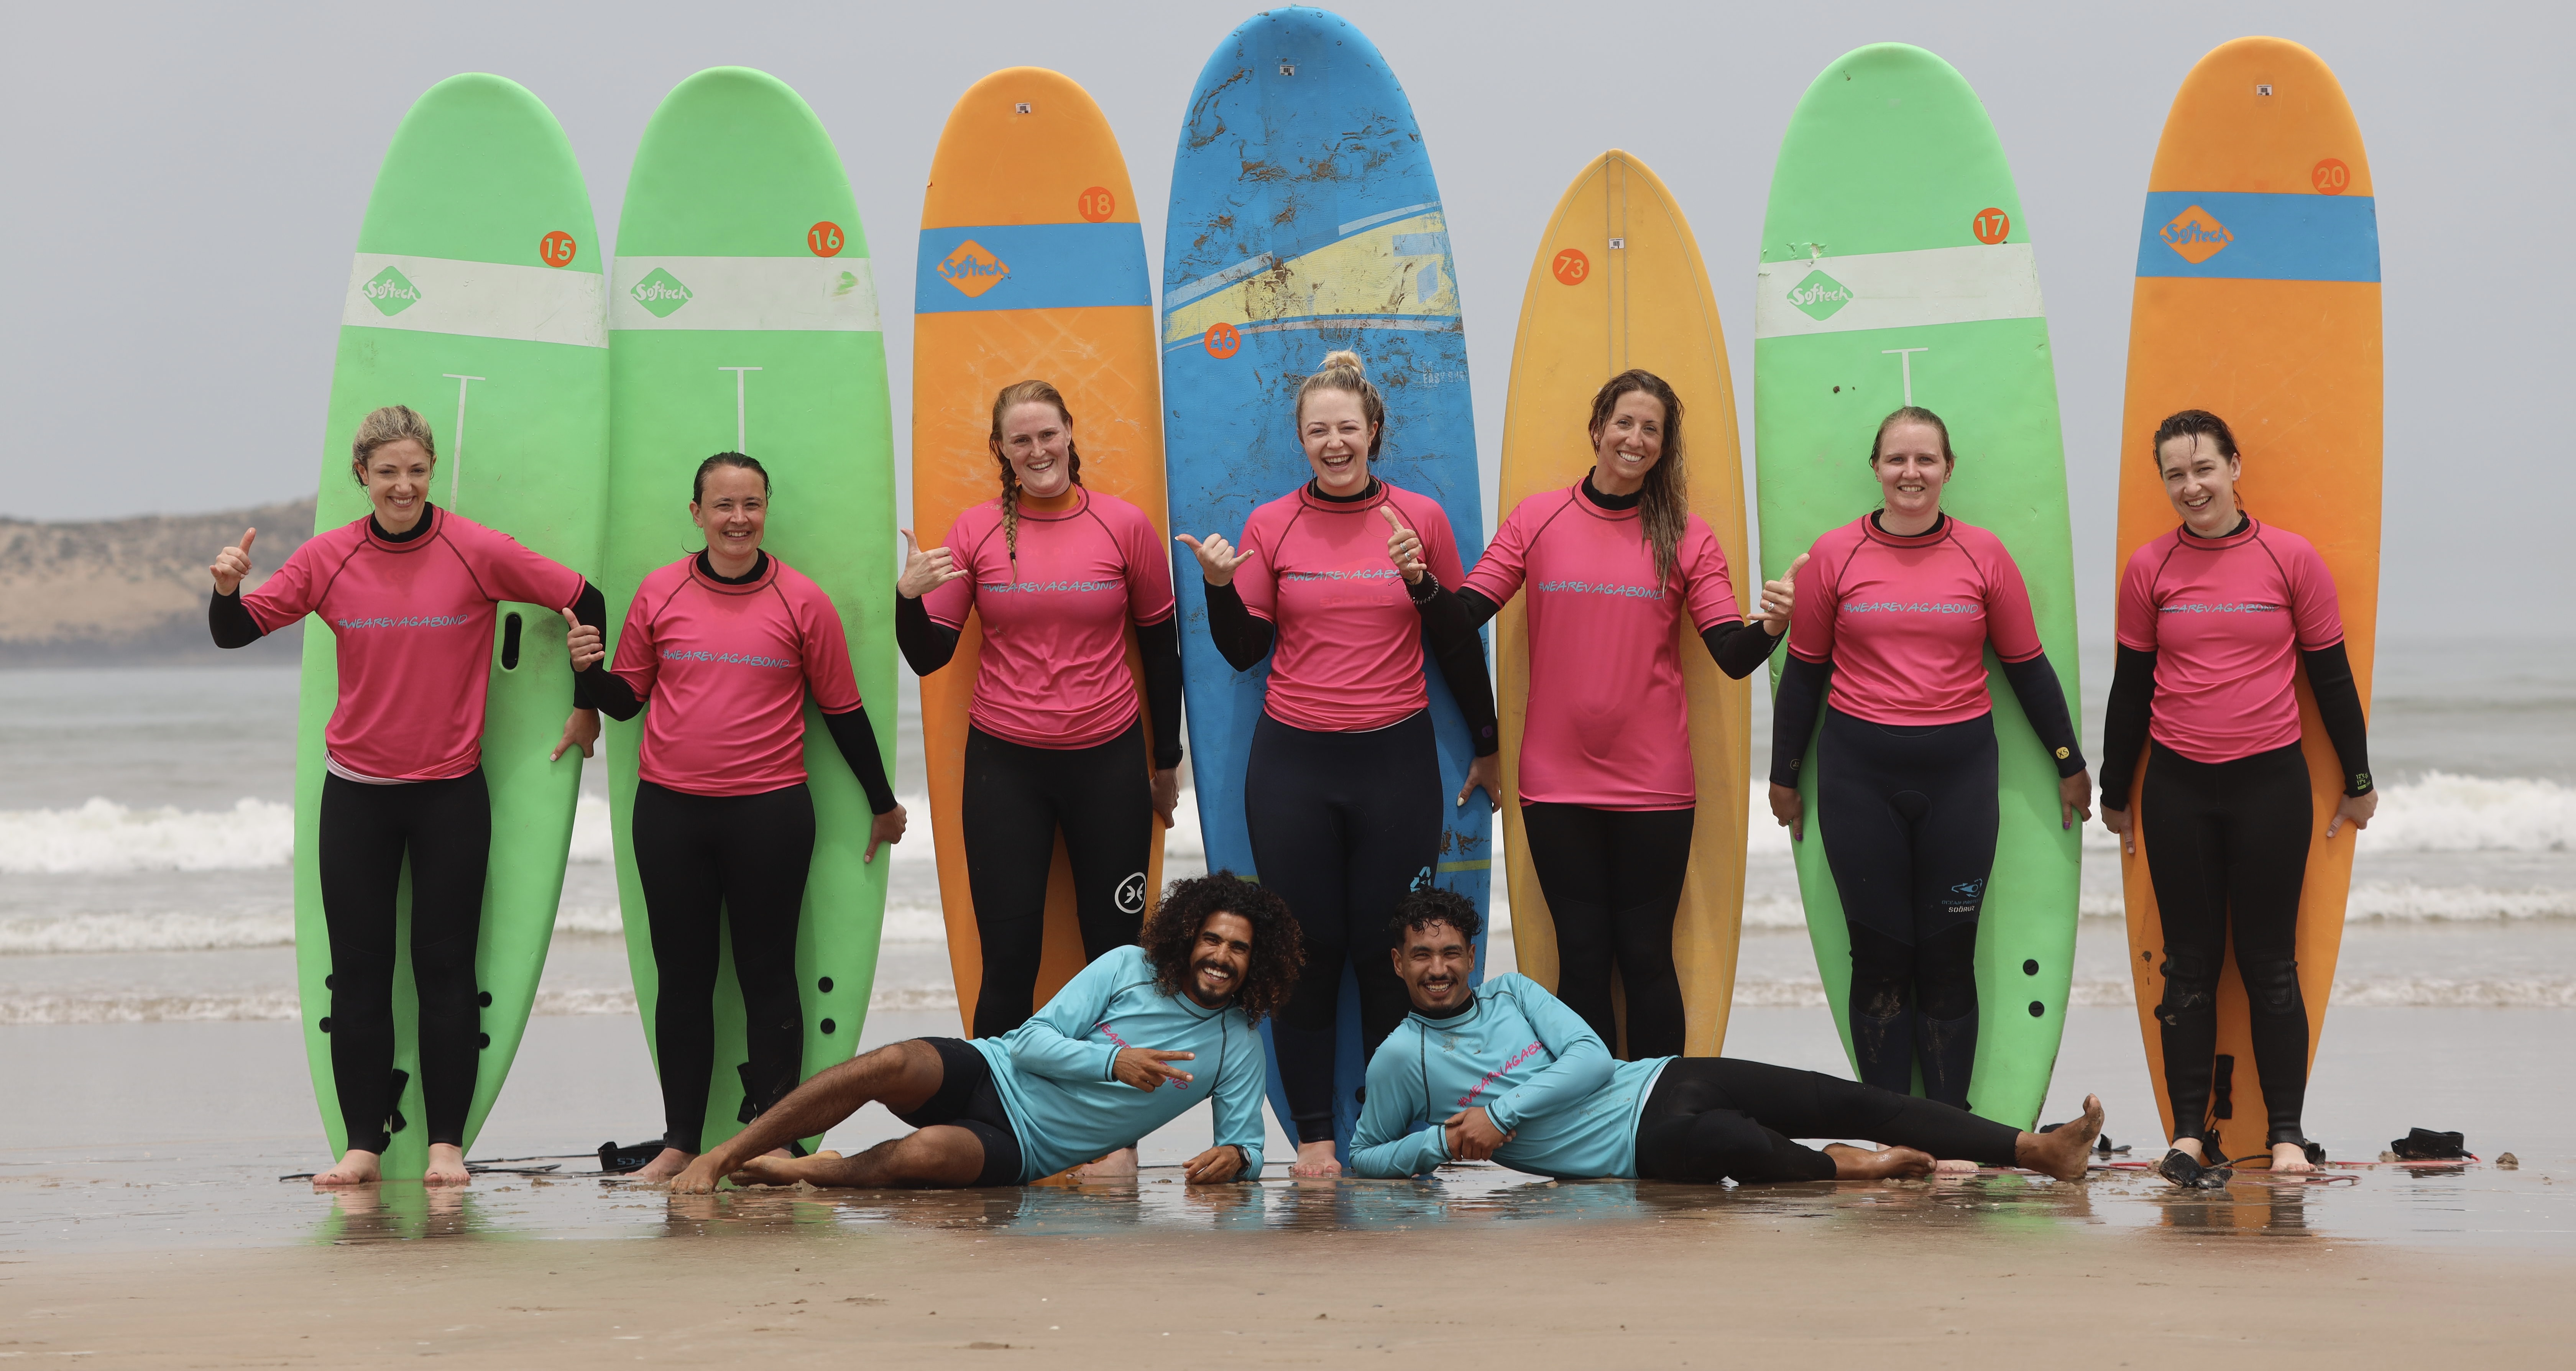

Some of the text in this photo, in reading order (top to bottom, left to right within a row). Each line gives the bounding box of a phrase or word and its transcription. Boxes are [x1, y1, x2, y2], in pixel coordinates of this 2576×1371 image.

[2317, 166, 2345, 188] 20
[1083, 194, 1111, 215] 18
[1977, 214, 2005, 237] 17
[2160, 220, 2233, 244] Softech
[545, 238, 572, 260] 15
[811, 228, 840, 250] 16
[937, 254, 1005, 279] Softech
[1558, 256, 1584, 278] 73
[363, 279, 421, 302] Softech
[631, 280, 690, 301] Softech
[1787, 283, 1852, 305] Softech
[1211, 330, 1235, 351] 46
[1287, 568, 1401, 582] #WEAREVAGABO
[982, 580, 1118, 593] #WEAREVAGABOND
[1843, 602, 1979, 614] #WEAREVAGABOND
[337, 614, 468, 629] #WEAREVAGABOND
[663, 648, 791, 669] #WEAREVAGABOND
[2057, 749, 2069, 758] XS
